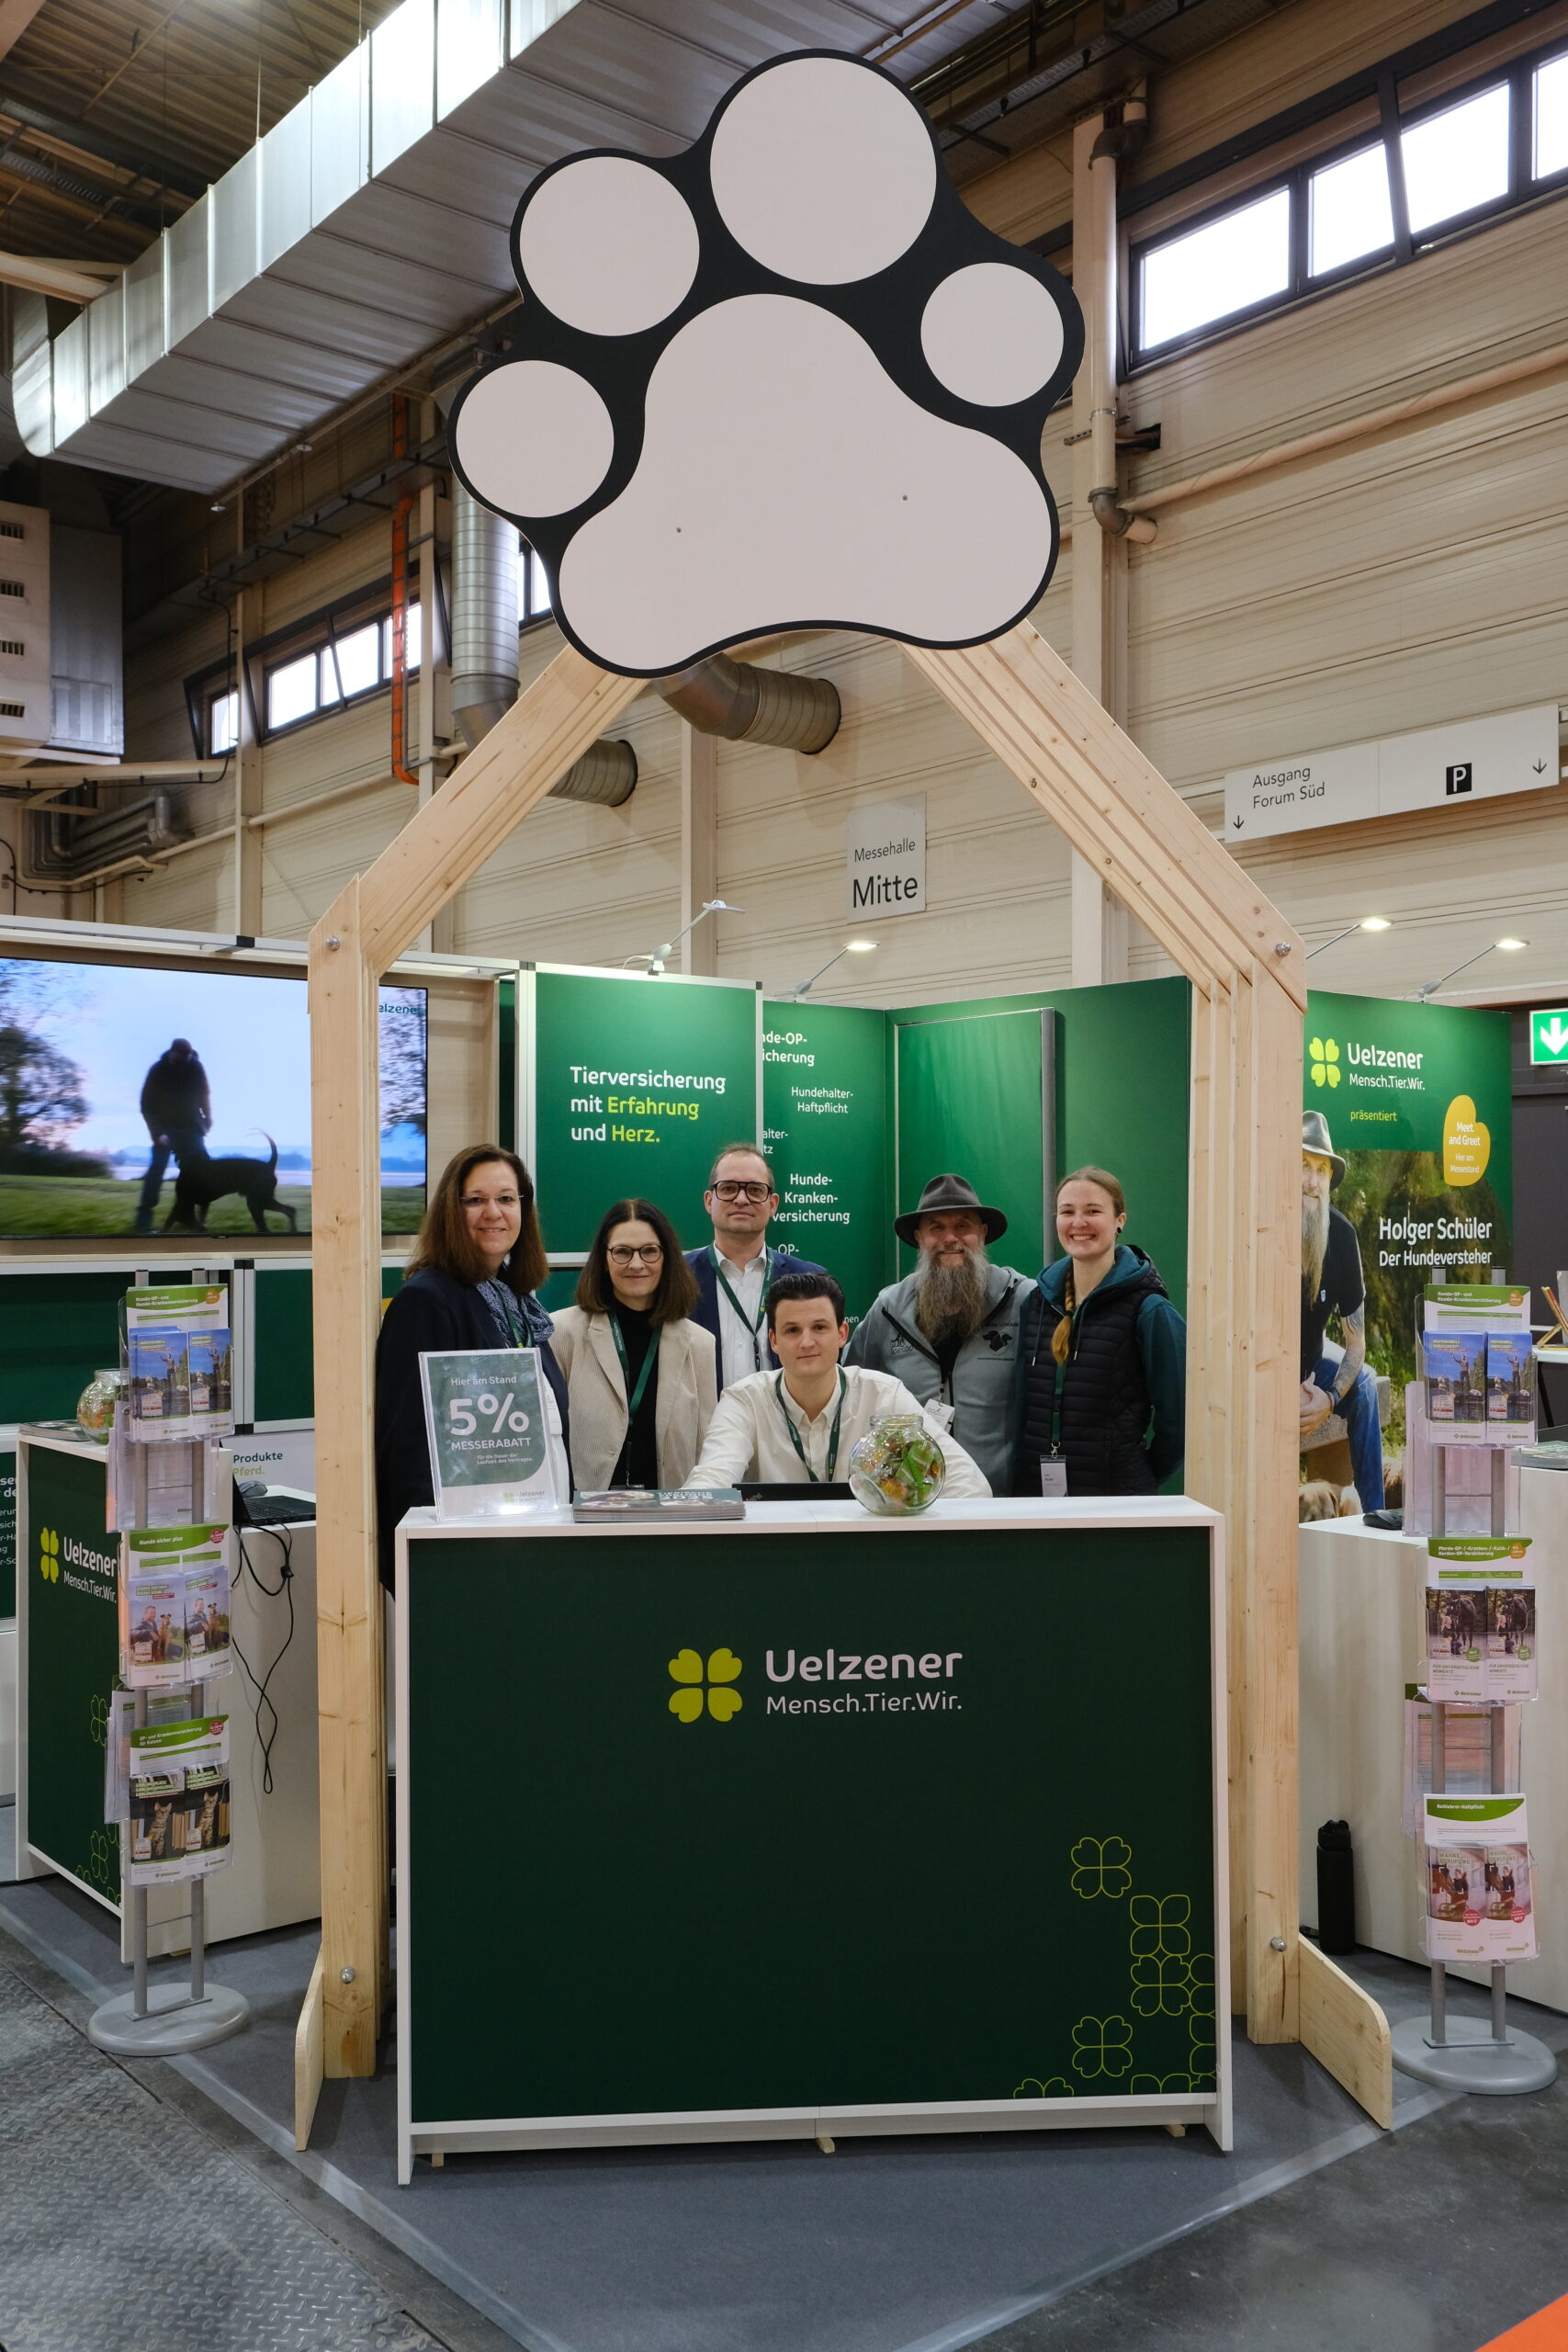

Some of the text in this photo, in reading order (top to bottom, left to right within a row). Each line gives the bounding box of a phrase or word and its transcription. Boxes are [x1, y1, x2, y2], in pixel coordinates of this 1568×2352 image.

[1252, 766, 1311, 788] Ausgang
[1452, 766, 1467, 792] P
[1252, 782, 1325, 808] Forum Süd
[854, 837, 916, 863] Messehalle
[853, 875, 918, 908] Mitte
[762, 1048, 816, 1067] icherung
[1348, 1043, 1424, 1069] Uelzener
[570, 1066, 727, 1094] Tierversicherung
[1349, 1073, 1426, 1091] Mensch.Tier.Wir.
[791, 1086, 853, 1099] Hundehalter-
[570, 1096, 699, 1120] mit Erfahrung
[797, 1102, 849, 1114] Haftpflicht
[1350, 1110, 1397, 1123] präsentiert
[571, 1124, 660, 1143] und Herz.
[762, 1128, 789, 1139] alter-
[1456, 1122, 1473, 1133] Meet
[1449, 1135, 1481, 1147] and Greet
[790, 1173, 833, 1185] Hunde-
[784, 1192, 838, 1204] Kranken-
[773, 1210, 851, 1225] versicherung
[1379, 1216, 1493, 1245] Holger Schüler
[1379, 1249, 1493, 1267] Der Hundeversteher
[450, 1377, 469, 1386] Hier
[489, 1375, 517, 1385] Stand
[449, 1393, 530, 1435] 5%
[451, 1438, 531, 1451] MESSERABATT
[233, 1452, 283, 1464] Produkte
[232, 1465, 265, 1476] Pferd.
[63, 1536, 117, 1577] Uelzener
[63, 1570, 117, 1604] Mensch.Tier.Wir.
[765, 1648, 963, 1682] Uelzener
[766, 1690, 963, 1714] Mensch.Tier.Wir.
